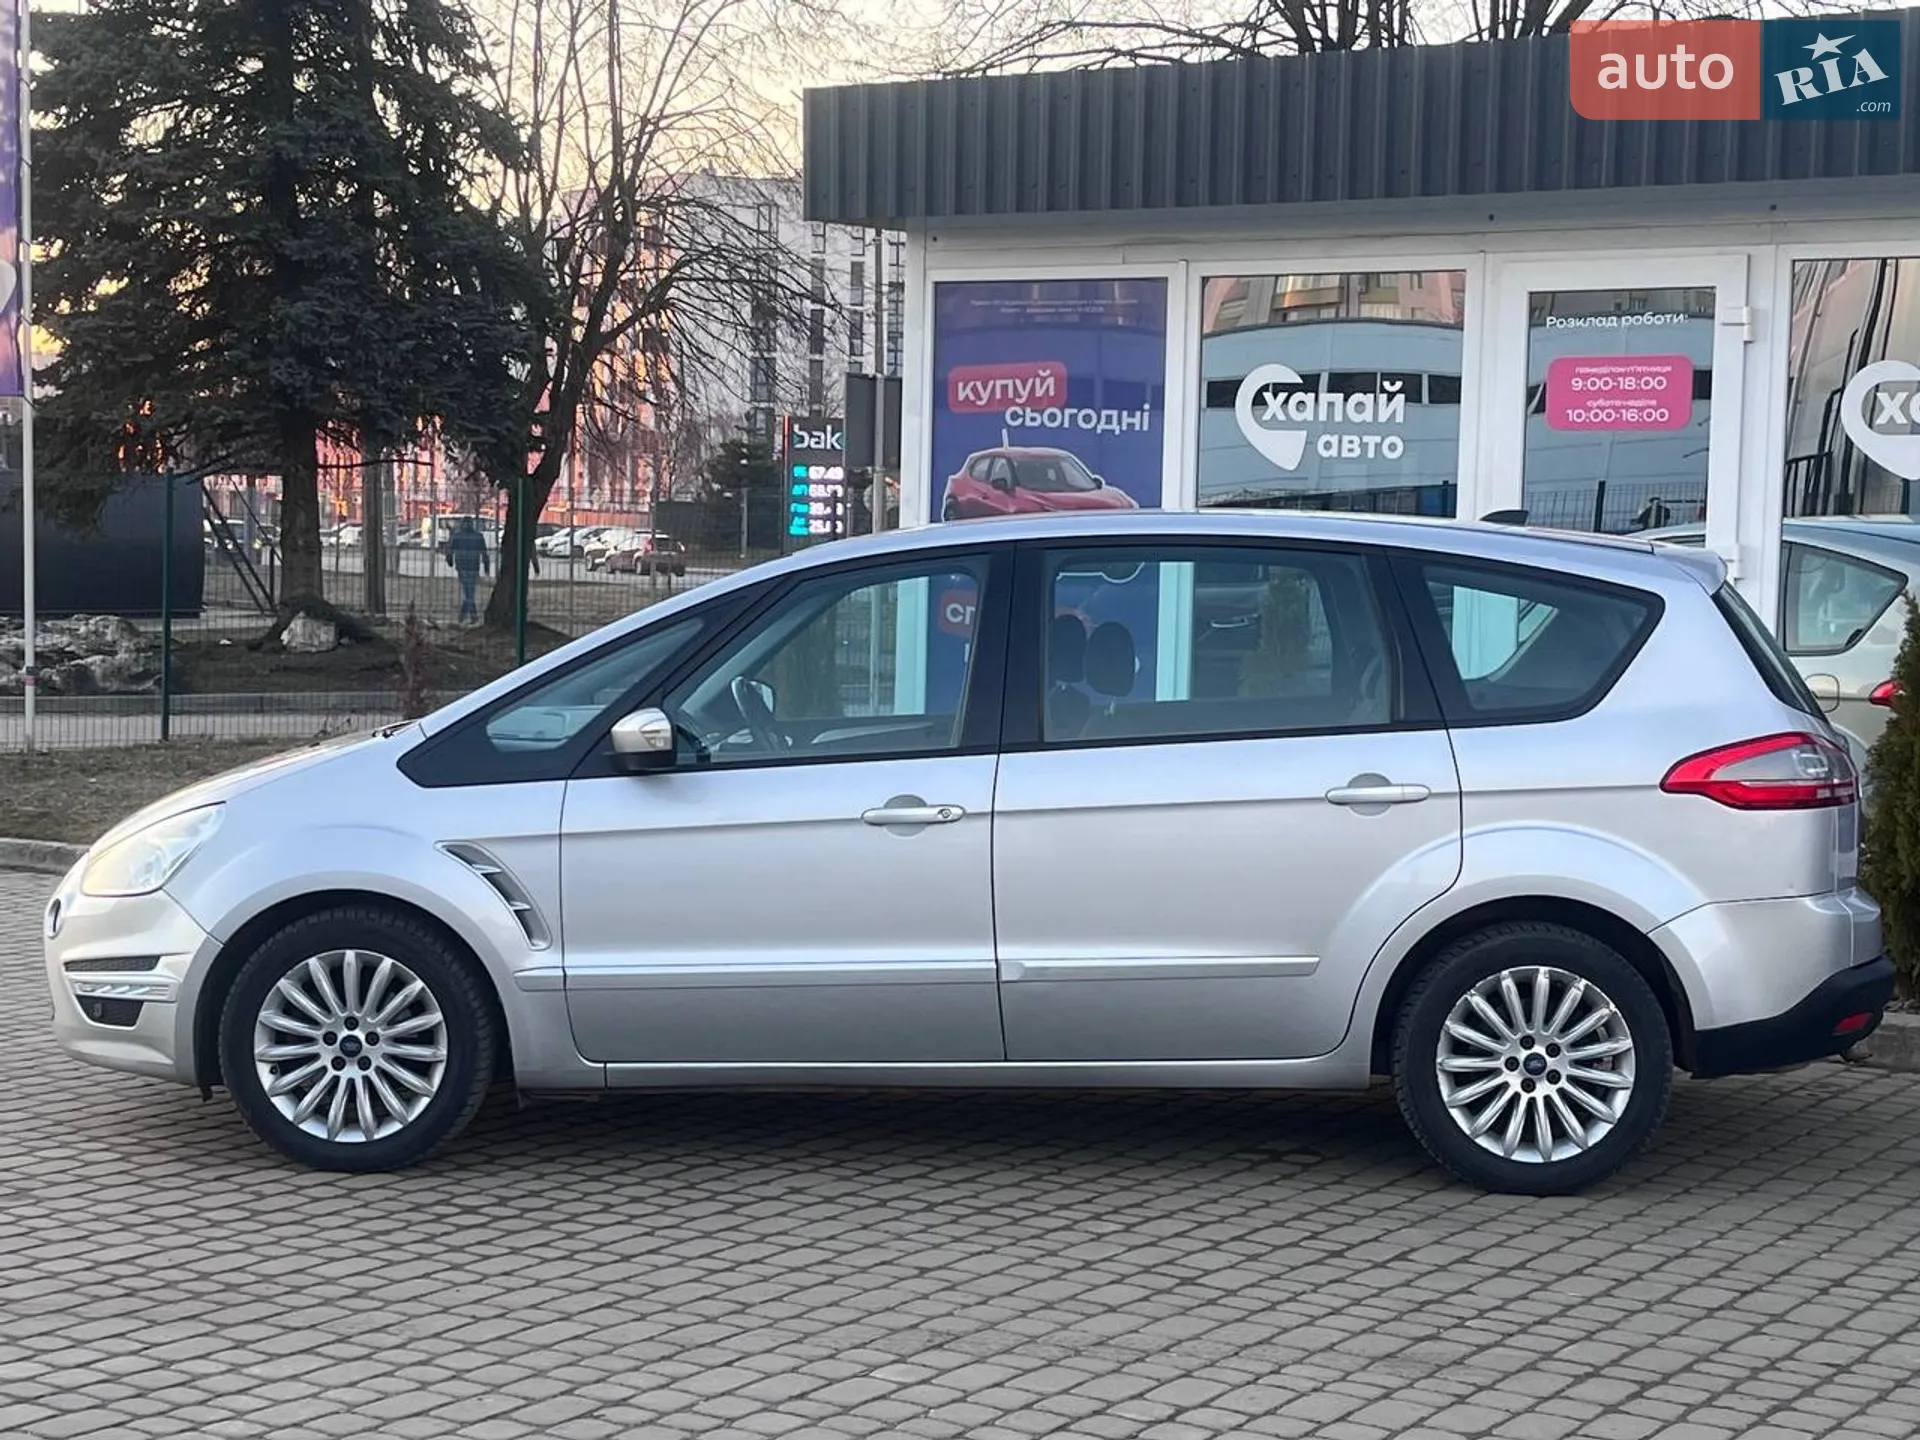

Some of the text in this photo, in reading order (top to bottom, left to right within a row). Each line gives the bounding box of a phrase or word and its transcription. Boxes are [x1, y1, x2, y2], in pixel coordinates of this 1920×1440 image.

[1546, 312, 1688, 328] Розклад роботи:
[957, 369, 1055, 405] купуй
[1571, 376, 1667, 391] 9:00-18:00
[1262, 380, 1405, 423] хапай
[1004, 403, 1150, 435] сьогодні
[1566, 408, 1669, 422] 10:00-16:00
[793, 424, 842, 449] bak
[1317, 434, 1404, 459] авто
